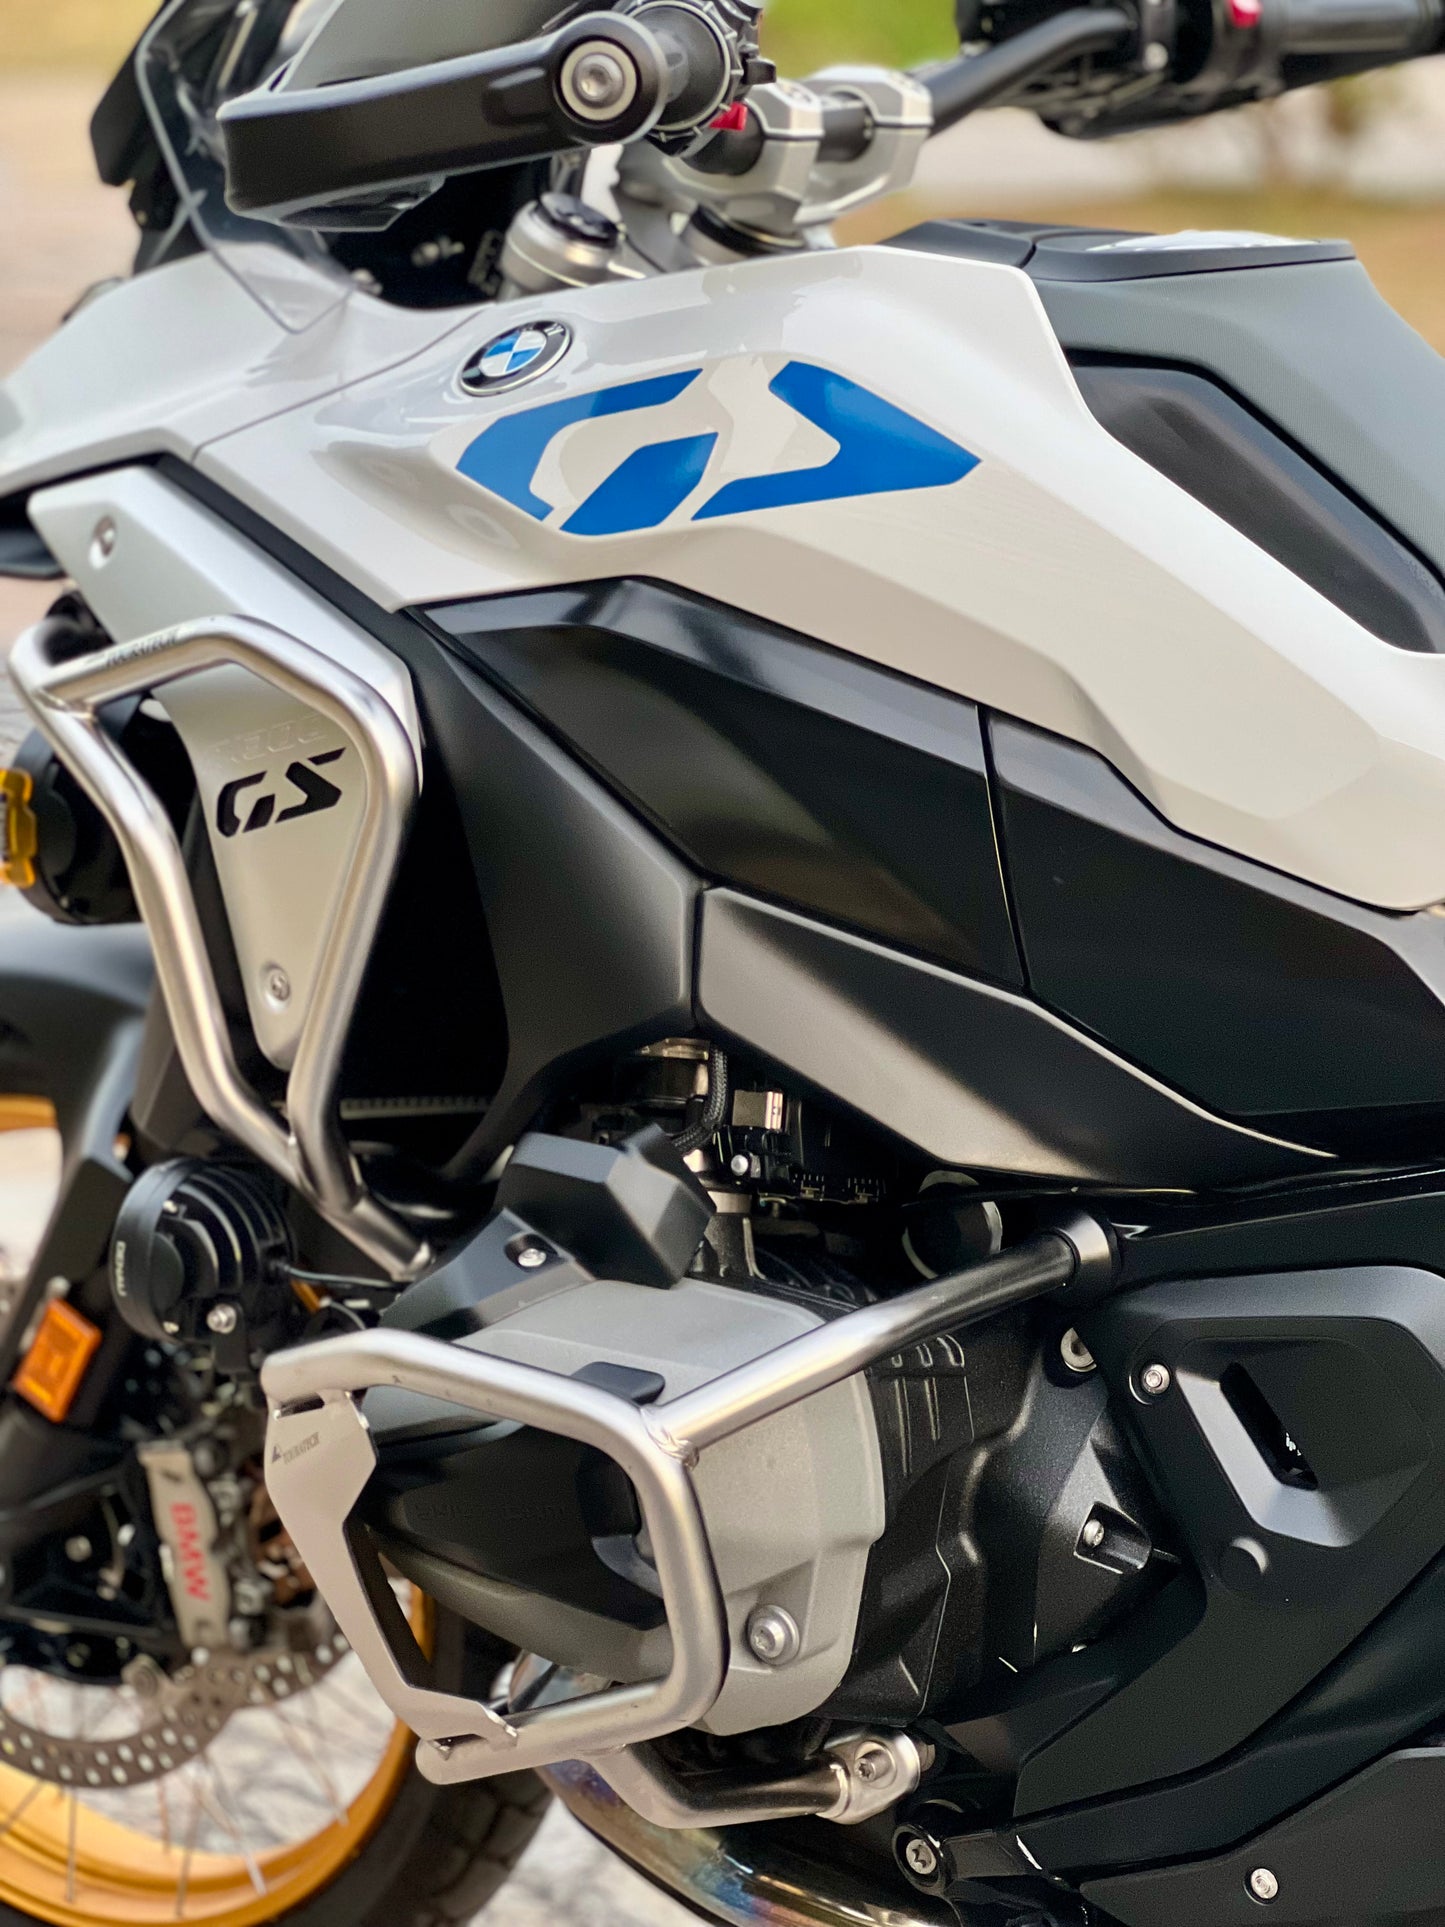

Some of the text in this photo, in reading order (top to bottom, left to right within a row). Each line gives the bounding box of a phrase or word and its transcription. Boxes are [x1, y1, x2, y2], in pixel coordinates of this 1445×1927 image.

[456, 360, 982, 537] GS
[216, 747, 347, 838] GS
[170, 1502, 214, 1603] BMW
